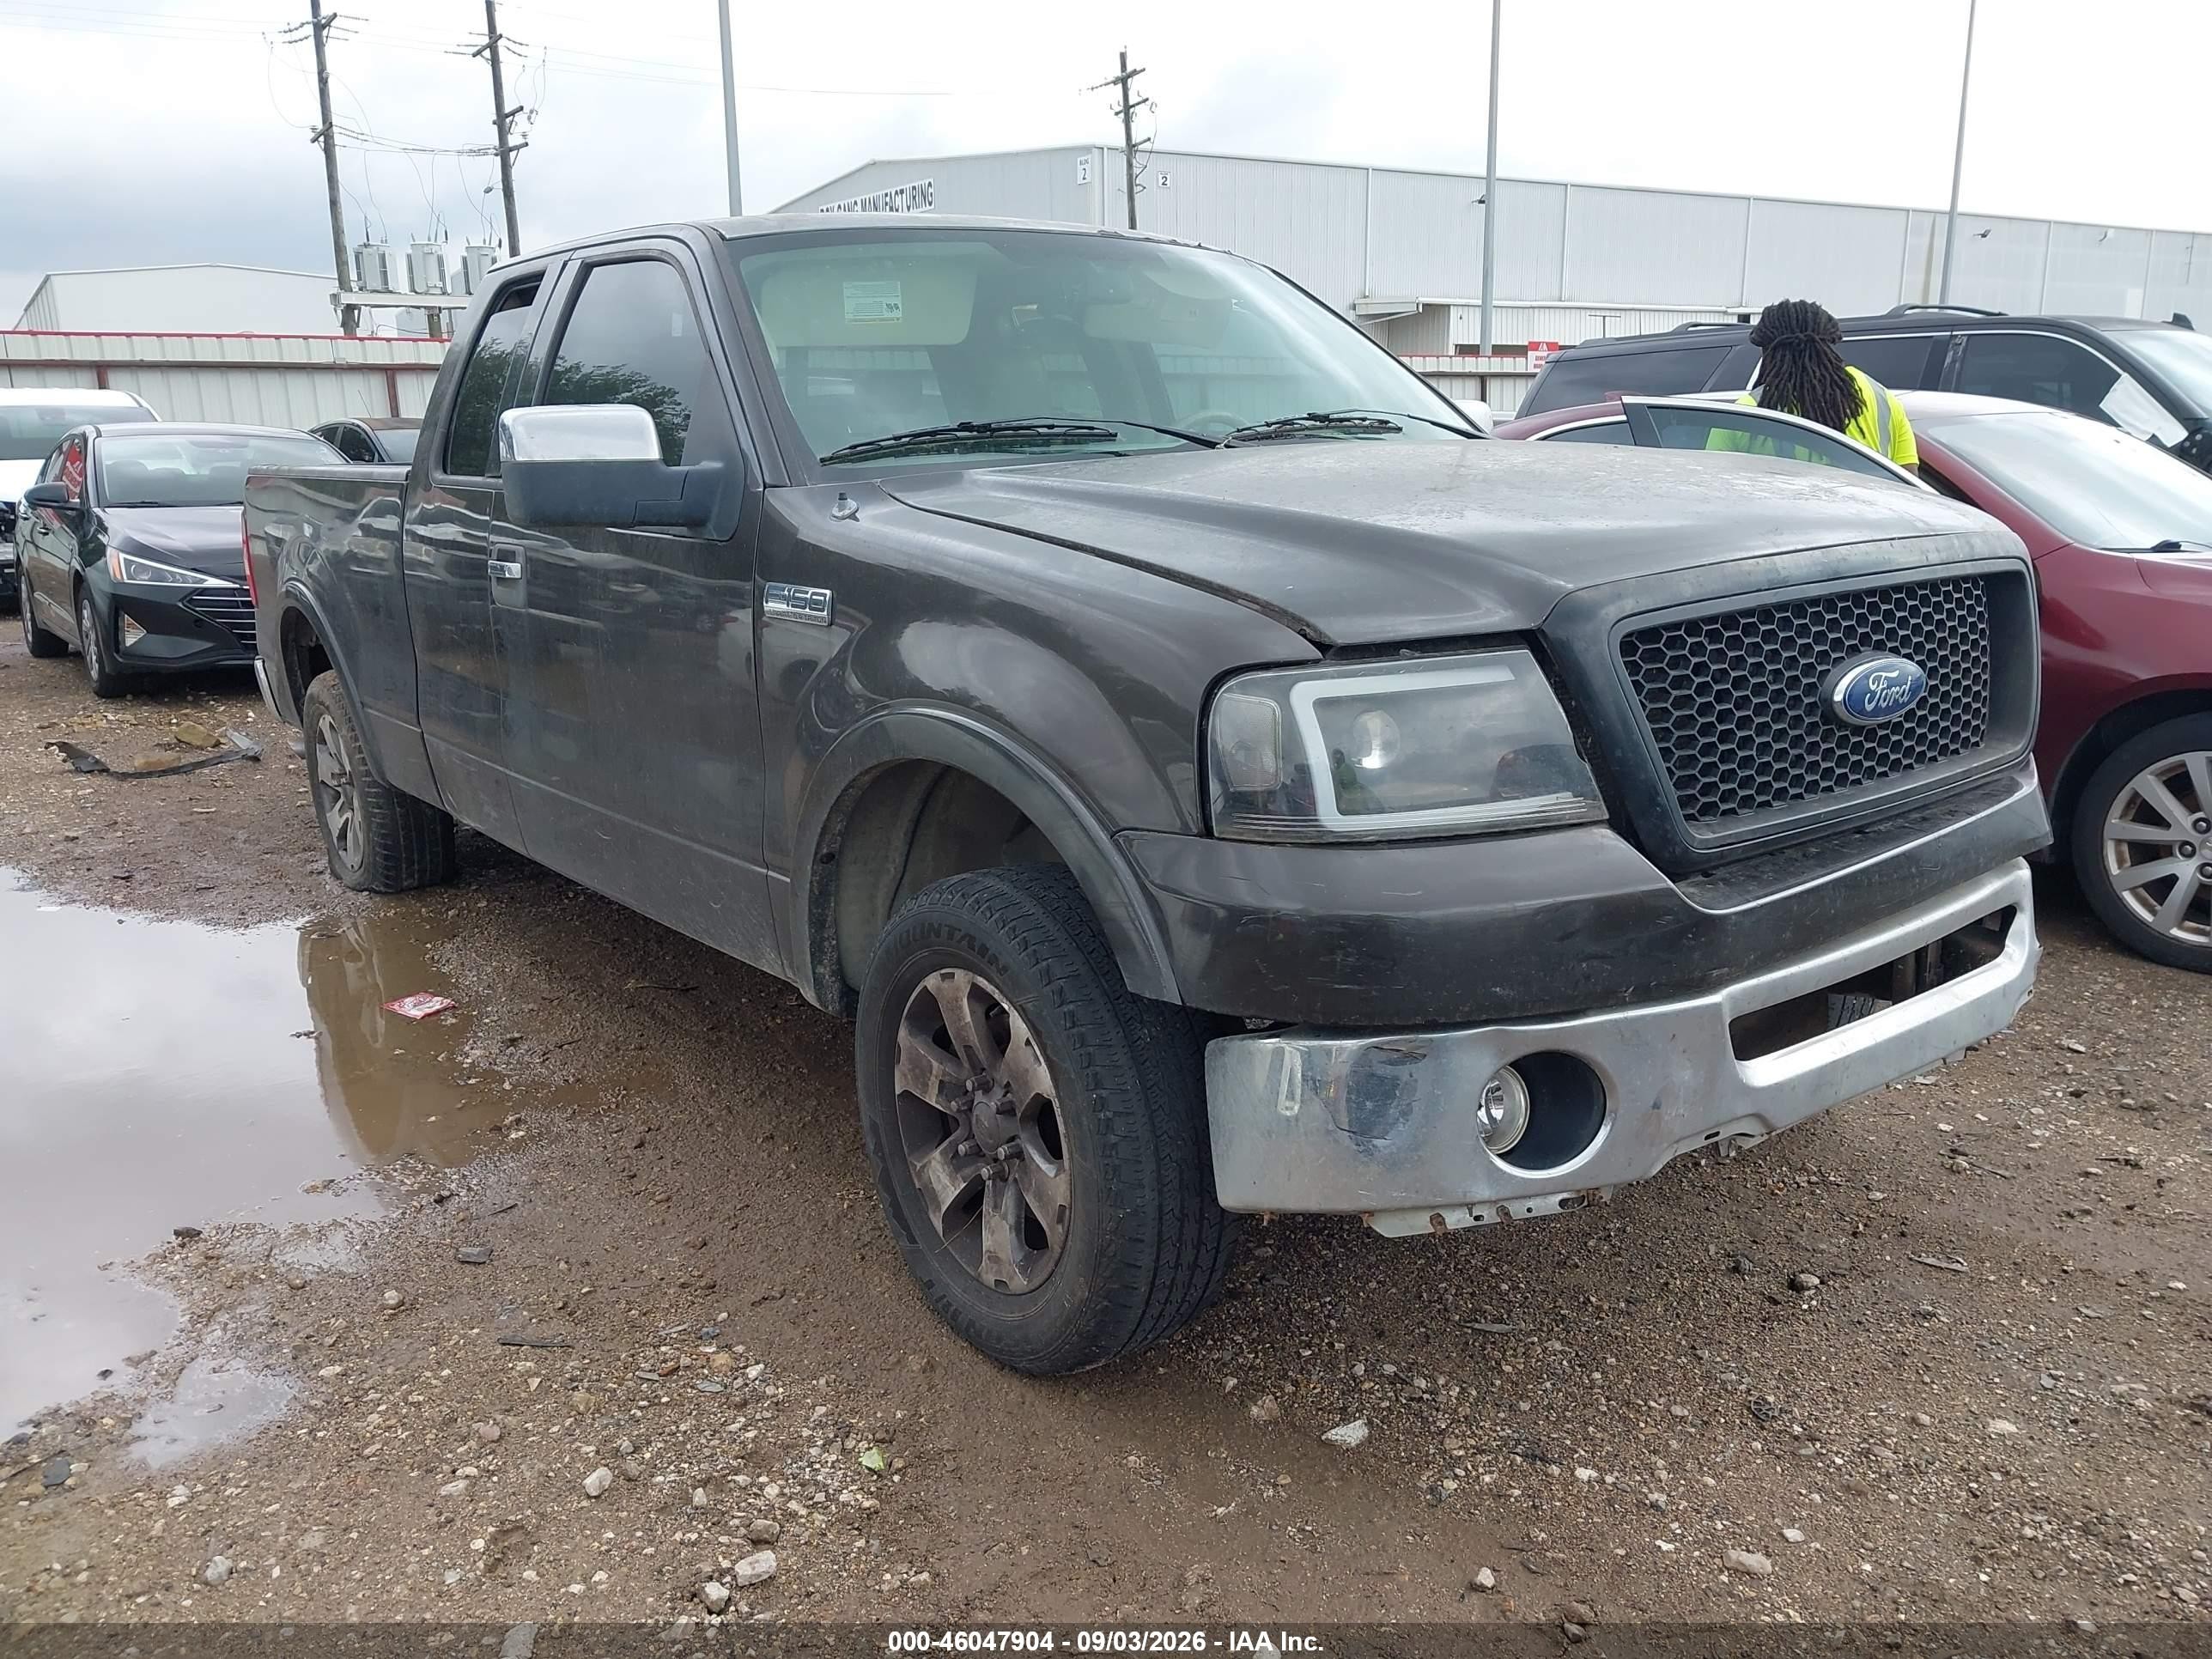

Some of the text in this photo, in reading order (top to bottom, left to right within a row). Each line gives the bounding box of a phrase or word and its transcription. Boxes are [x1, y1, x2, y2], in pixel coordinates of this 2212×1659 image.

[1082, 167, 1087, 180] 2
[1161, 176, 1168, 186] 2
[860, 180, 933, 213] MANUFACTURING
[1864, 669, 1912, 712] Ford
